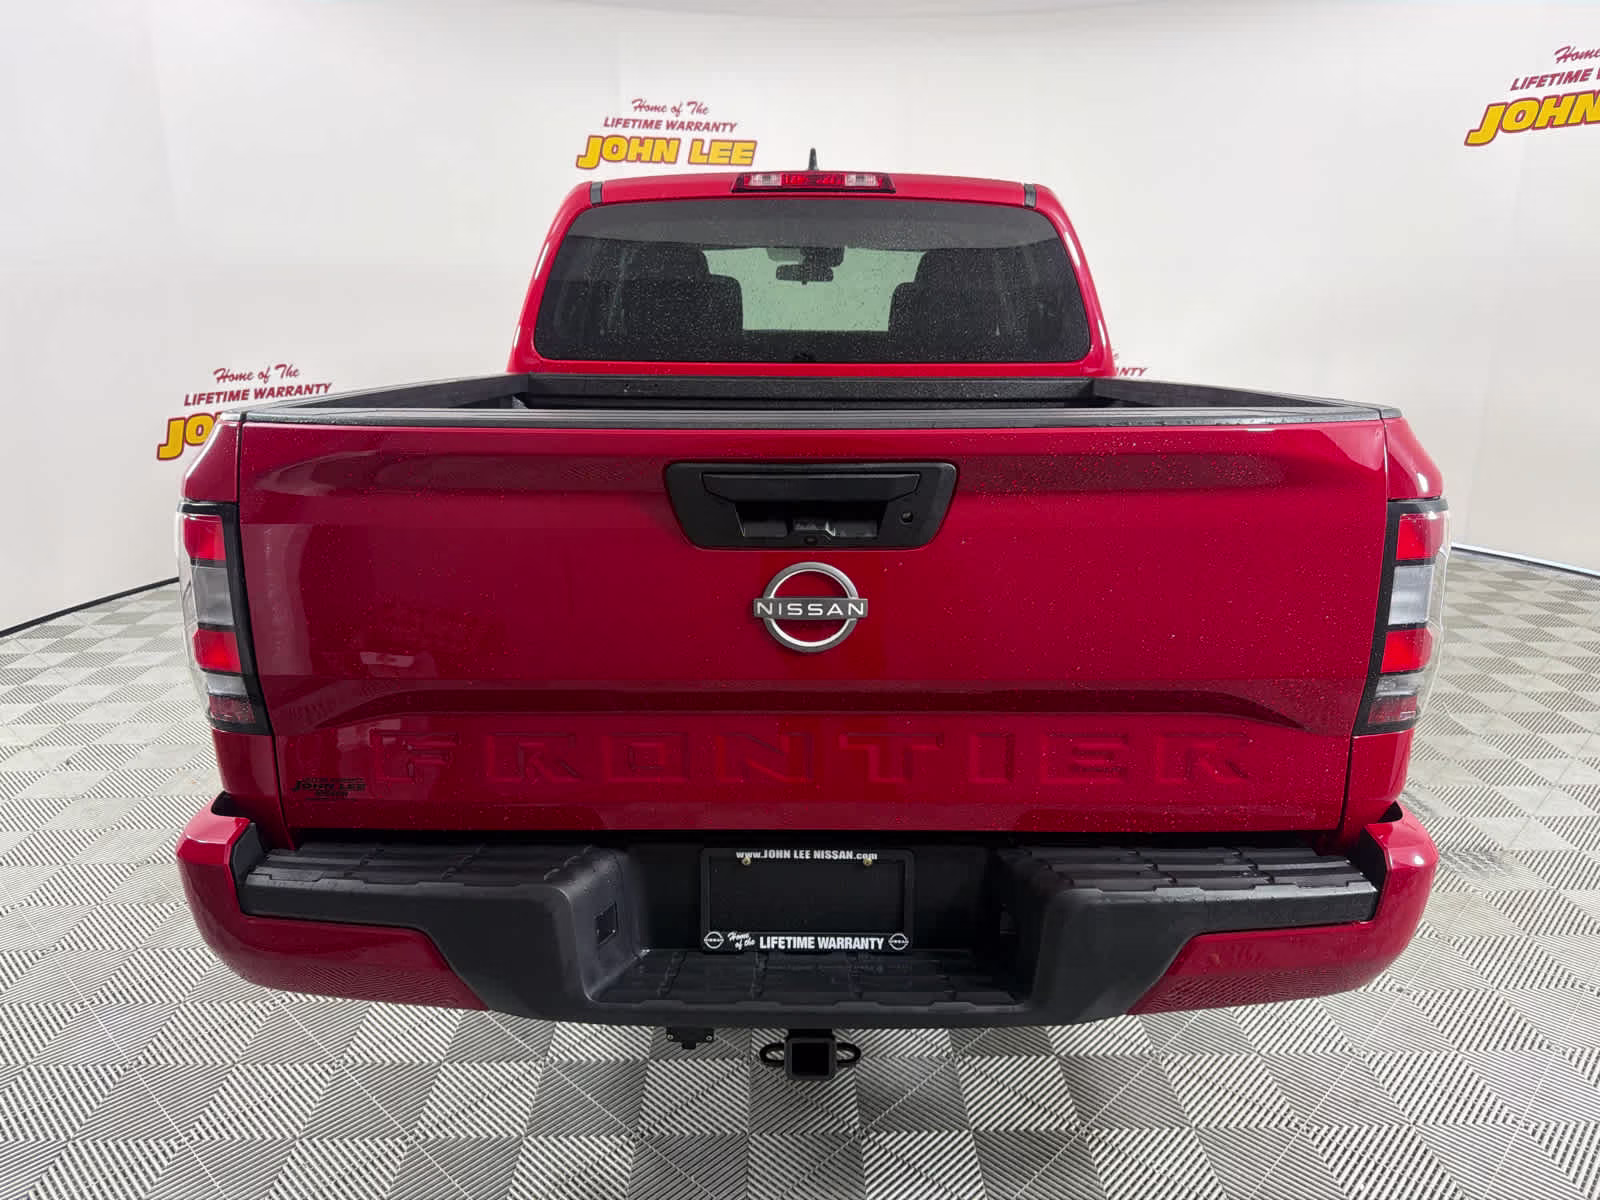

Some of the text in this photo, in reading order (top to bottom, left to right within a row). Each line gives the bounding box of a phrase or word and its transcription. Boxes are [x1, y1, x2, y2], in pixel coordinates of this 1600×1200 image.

[1510, 67, 1594, 91] LIFETIME
[631, 98, 709, 117] Home of The
[1464, 89, 1600, 147] JOHN
[603, 117, 737, 133] LIFETIME WARRANTY
[576, 135, 757, 170] JOHN LEE
[213, 364, 300, 384] Home of The
[184, 383, 332, 406] LIFETIME WARRANTY
[156, 411, 223, 461] JO
[756, 602, 864, 616] NISSAN
[369, 730, 1249, 784] FRONTIER
[794, 849, 811, 859] LEE
[759, 936, 884, 950] LIFETIME WARRANTY
